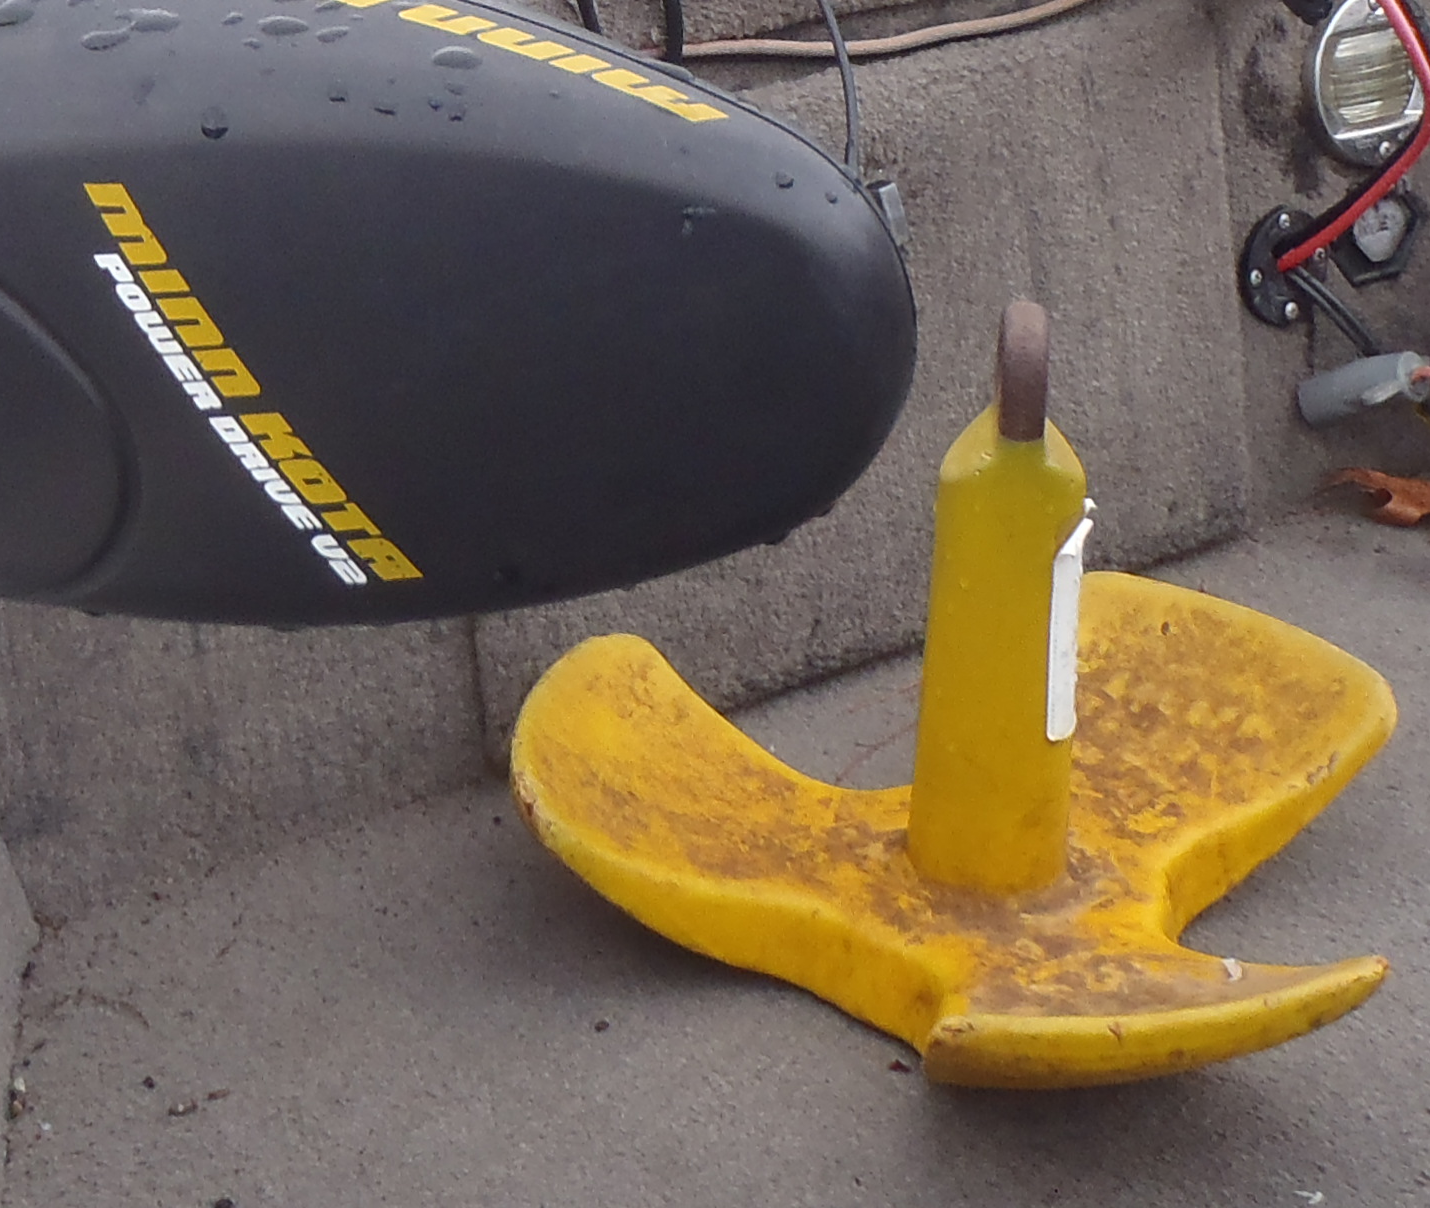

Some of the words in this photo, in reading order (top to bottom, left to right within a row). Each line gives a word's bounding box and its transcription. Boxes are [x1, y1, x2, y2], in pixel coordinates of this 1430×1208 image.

[398, 3, 729, 122] MINN
[83, 182, 261, 398] MINN
[239, 411, 424, 582] KOTA
[93, 253, 223, 410] POWER
[208, 416, 323, 530] DRIVE
[311, 533, 368, 587] V2
